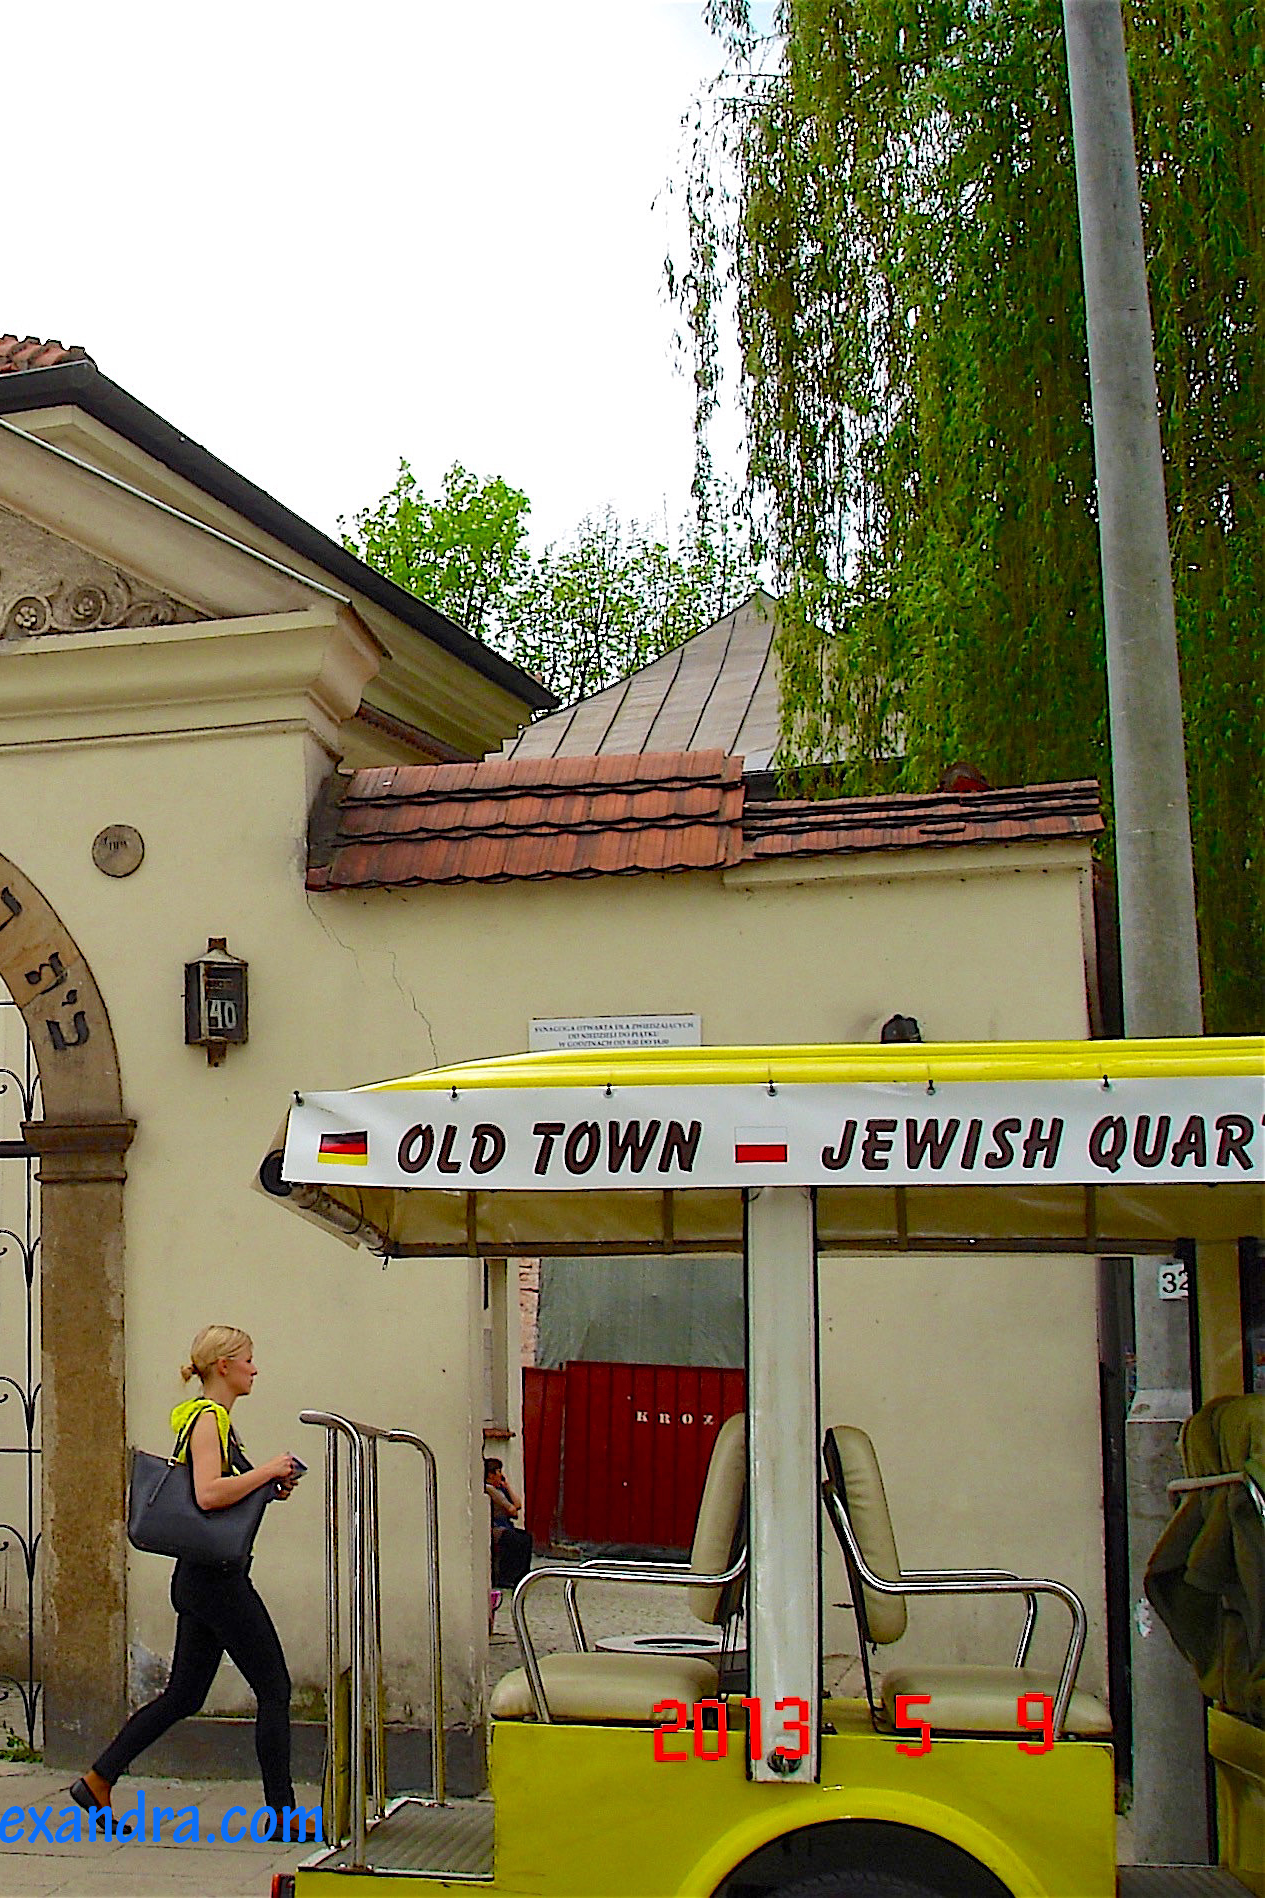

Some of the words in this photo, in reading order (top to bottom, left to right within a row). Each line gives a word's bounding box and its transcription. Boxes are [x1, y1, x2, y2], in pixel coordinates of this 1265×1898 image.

[24, 950, 90, 1052] בית
[209, 999, 237, 1029] 40
[397, 1123, 506, 1174] OLD
[533, 1120, 702, 1175] TOWN
[821, 1117, 1064, 1171] JEWISH
[1089, 1115, 1265, 1174] QUAR
